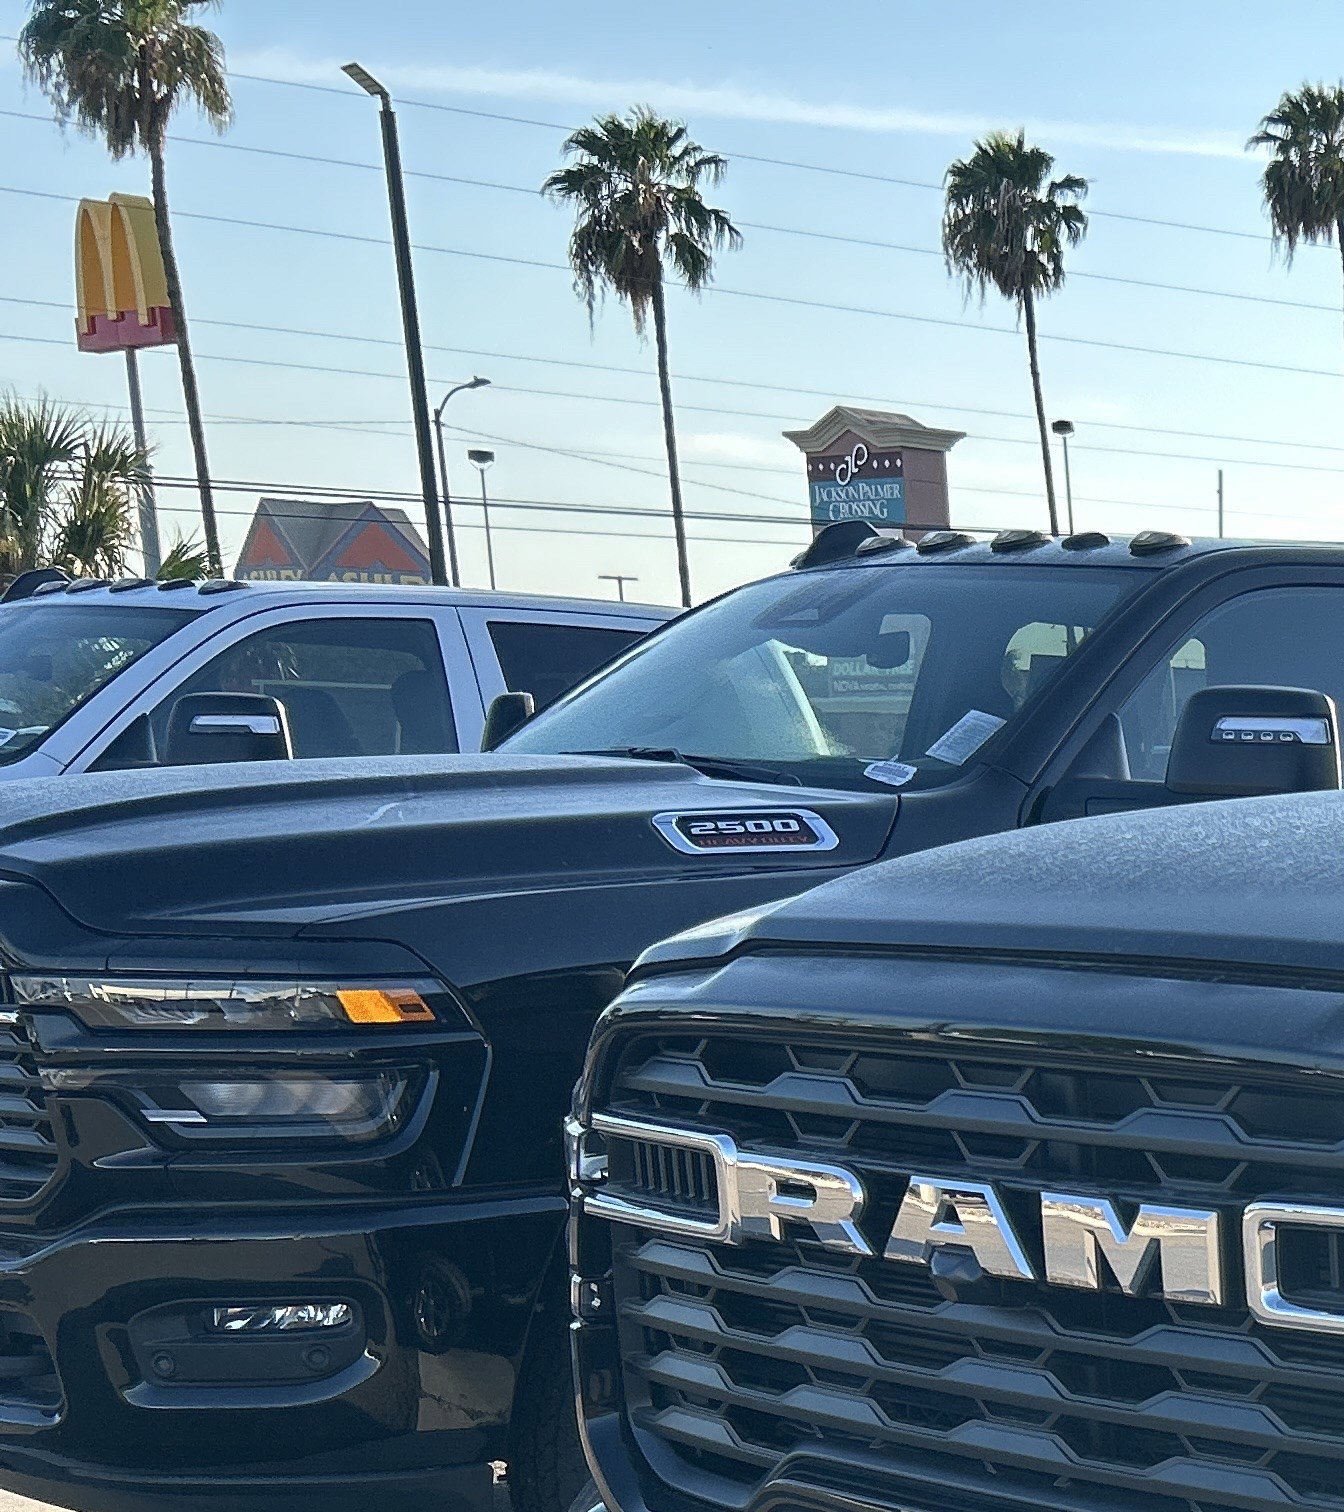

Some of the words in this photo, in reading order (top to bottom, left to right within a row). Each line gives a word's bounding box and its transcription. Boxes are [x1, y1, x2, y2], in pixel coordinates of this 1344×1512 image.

[829, 500, 888, 521] CROSSING
[688, 819, 800, 836] 2500
[733, 1152, 1222, 1307] RAM
